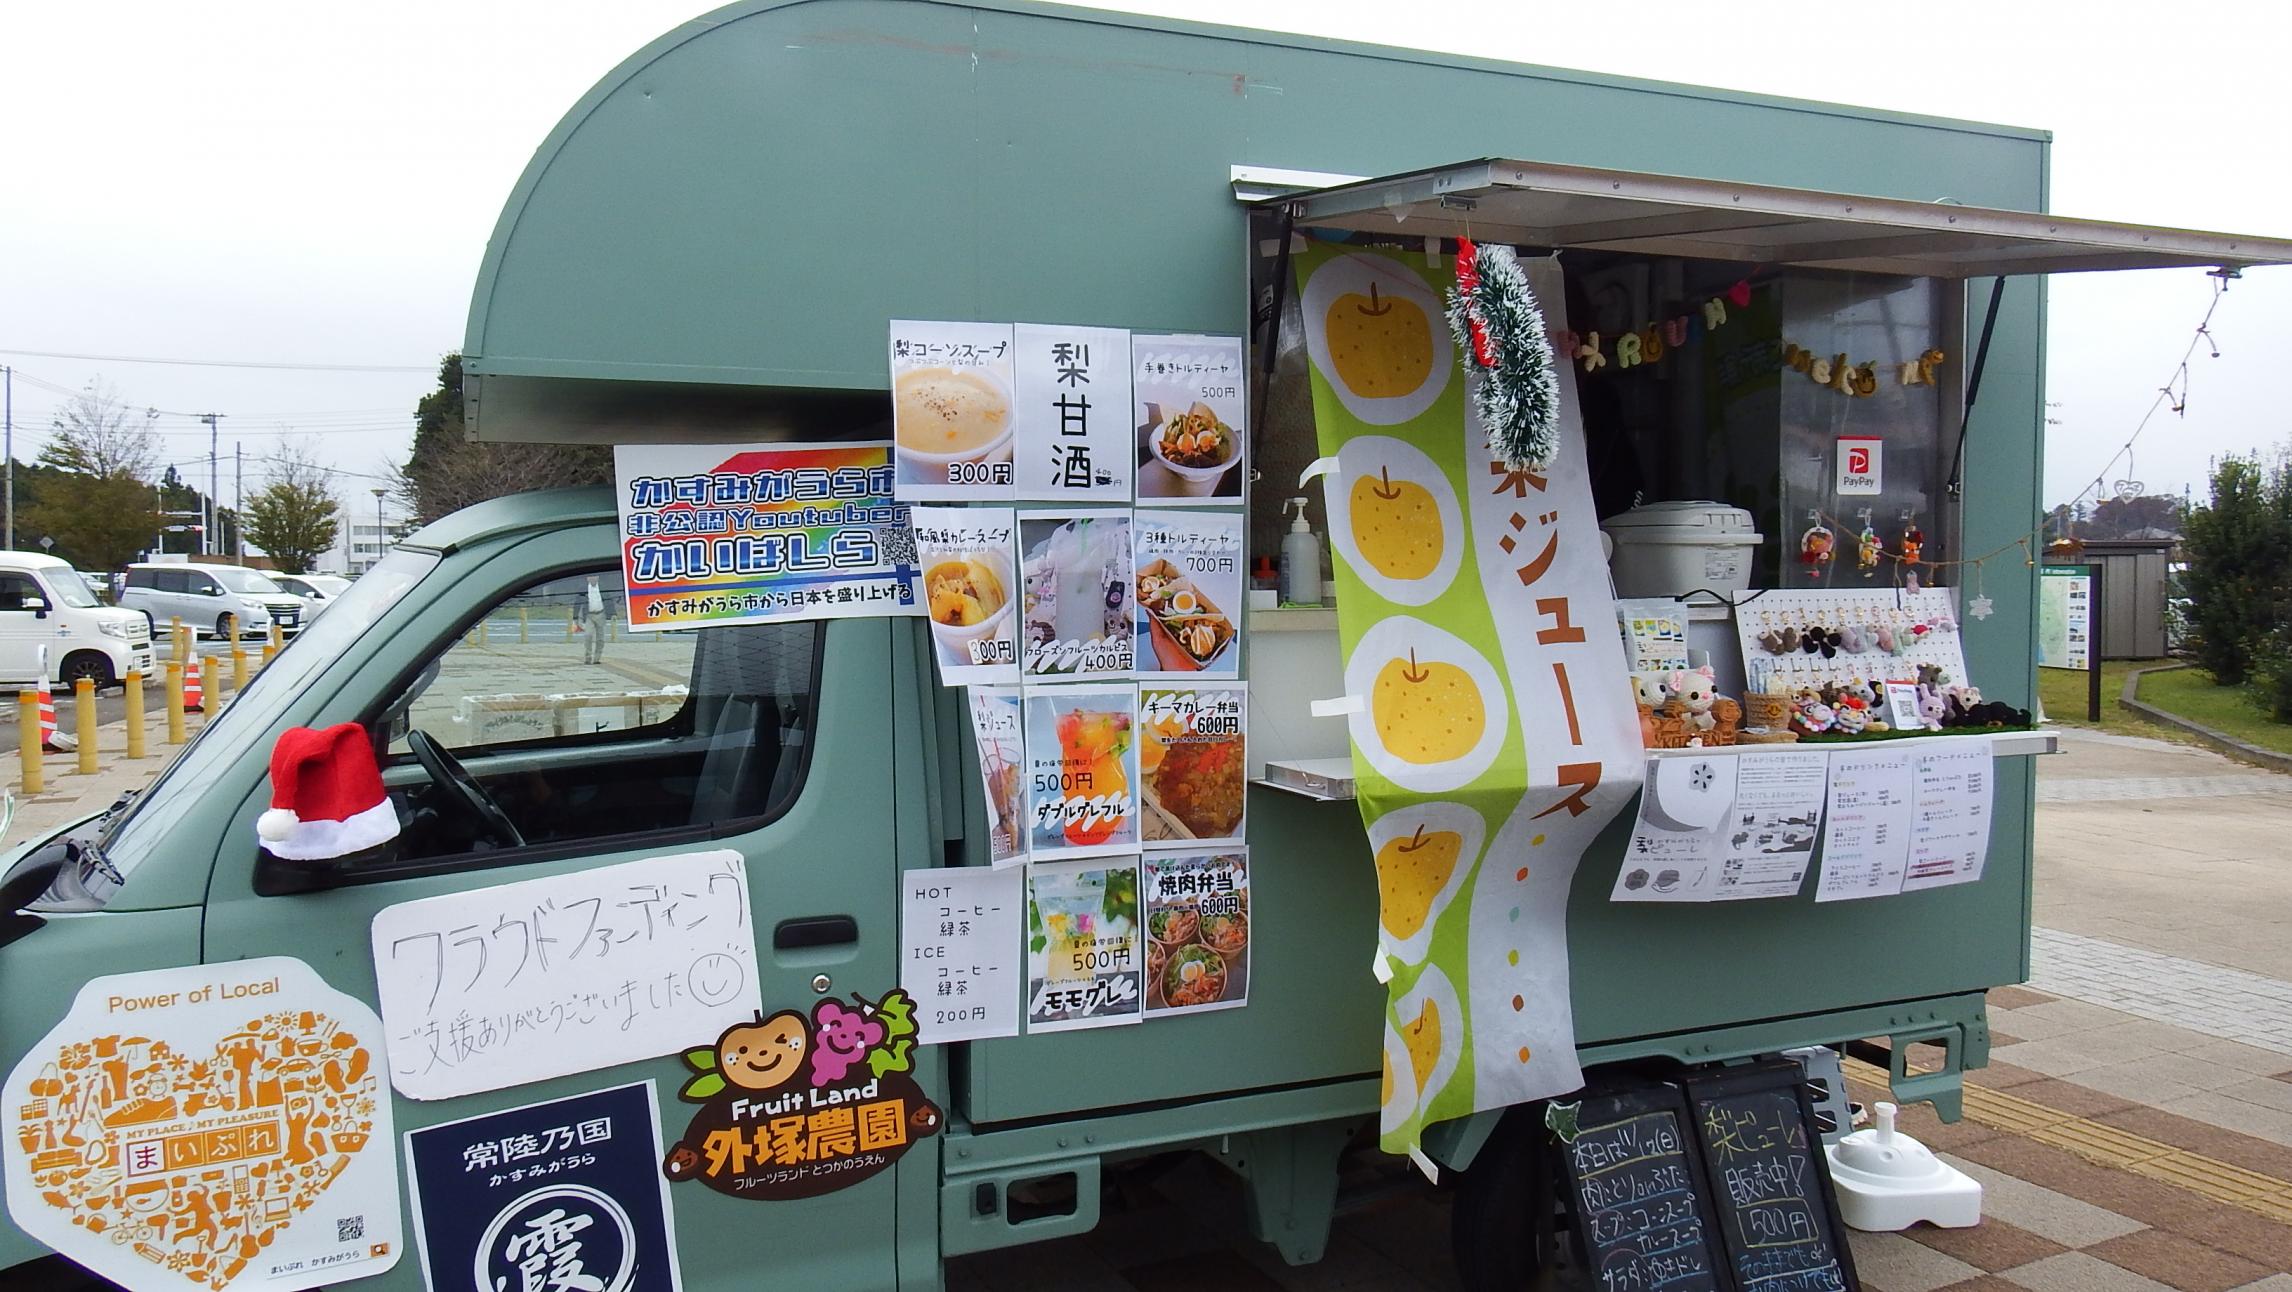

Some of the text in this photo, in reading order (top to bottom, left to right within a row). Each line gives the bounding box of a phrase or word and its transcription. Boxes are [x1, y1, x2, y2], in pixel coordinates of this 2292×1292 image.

[896, 339, 1007, 358] 梨コーンスープ
[1144, 362, 1229, 375] 手巻きトルティーヤ
[1201, 387, 1236, 398] 500円
[1051, 342, 1092, 488] 梨甘酒
[948, 462, 1012, 484] 300円
[1844, 476, 1874, 487] PayPay
[627, 501, 910, 535] 非公認Youtuber
[631, 531, 878, 581] かいばしら
[1186, 557, 1232, 572] 700円
[648, 583, 911, 617] かすみがうら市から日本を盛り上げる
[968, 640, 1013, 664] 300円
[1085, 653, 1133, 669] 400円
[1149, 701, 1239, 714] キーマカレー弁当
[1197, 716, 1239, 734] 600円
[1035, 773, 1093, 792] 500円
[1038, 802, 1125, 820] ダブルグレフル
[915, 887, 951, 899] HOT
[1159, 872, 1233, 896] 焼肉弁当
[940, 905, 1000, 917] コーヒー
[1202, 897, 1238, 915] 600円
[940, 921, 970, 936] 緑茶
[914, 947, 945, 959] ICE
[1073, 948, 1130, 971] 500円
[938, 966, 998, 977] コーヒー
[109, 977, 280, 1013] Power of Local
[937, 981, 967, 996] 緑茶
[1045, 981, 1121, 1009] モモグレ
[937, 1007, 985, 1024] 200円
[731, 1078, 878, 1121] Fruit Land
[127, 1110, 280, 1139] MY PLACE MY PLEASURE
[135, 1129, 274, 1169] まいぷれ
[463, 1116, 612, 1172] 常陸乃国
[702, 1099, 907, 1177] 外塚農園
[489, 1153, 597, 1187] かすみがうら
[734, 1153, 885, 1190] フルーツランド とつかのうえん
[1750, 1208, 1811, 1246] 500円
[506, 1208, 605, 1292] 霞
